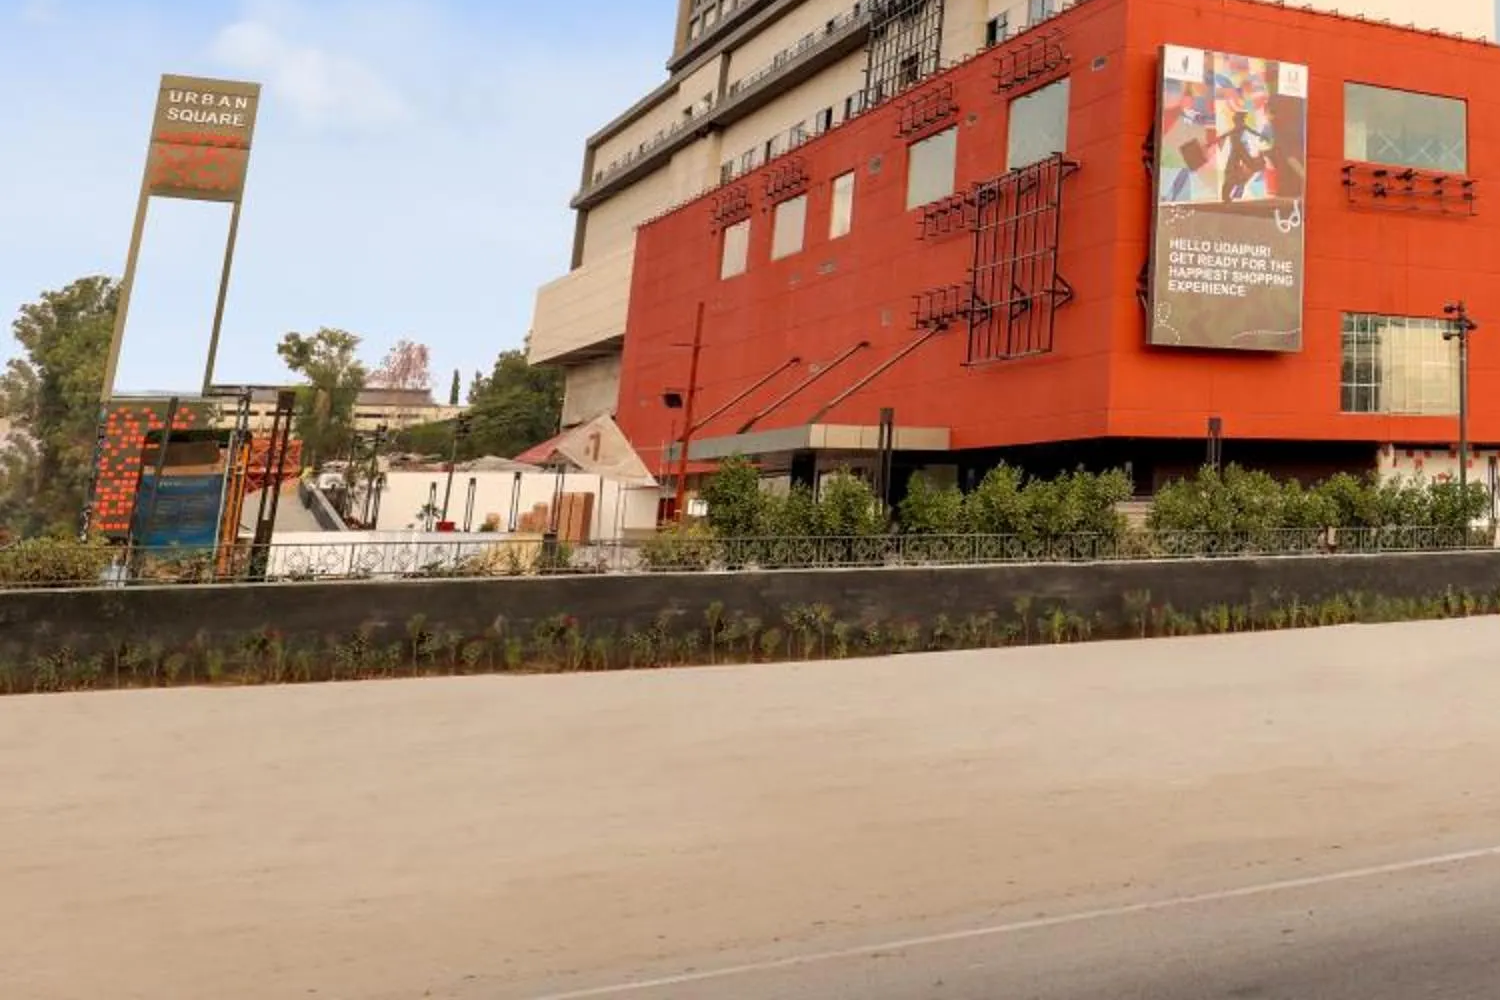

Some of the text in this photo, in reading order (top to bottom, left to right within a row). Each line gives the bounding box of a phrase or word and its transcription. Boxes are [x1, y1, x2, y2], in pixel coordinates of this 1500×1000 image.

[169, 90, 248, 108] URBAN
[167, 107, 246, 126] SQUARE
[1169, 238, 1211, 253] HELLO
[1169, 251, 1294, 273] GET READY FOR THE
[1167, 265, 1294, 286] HAPPIEST SHOPPING
[1167, 280, 1247, 296] EXPERIENCE
